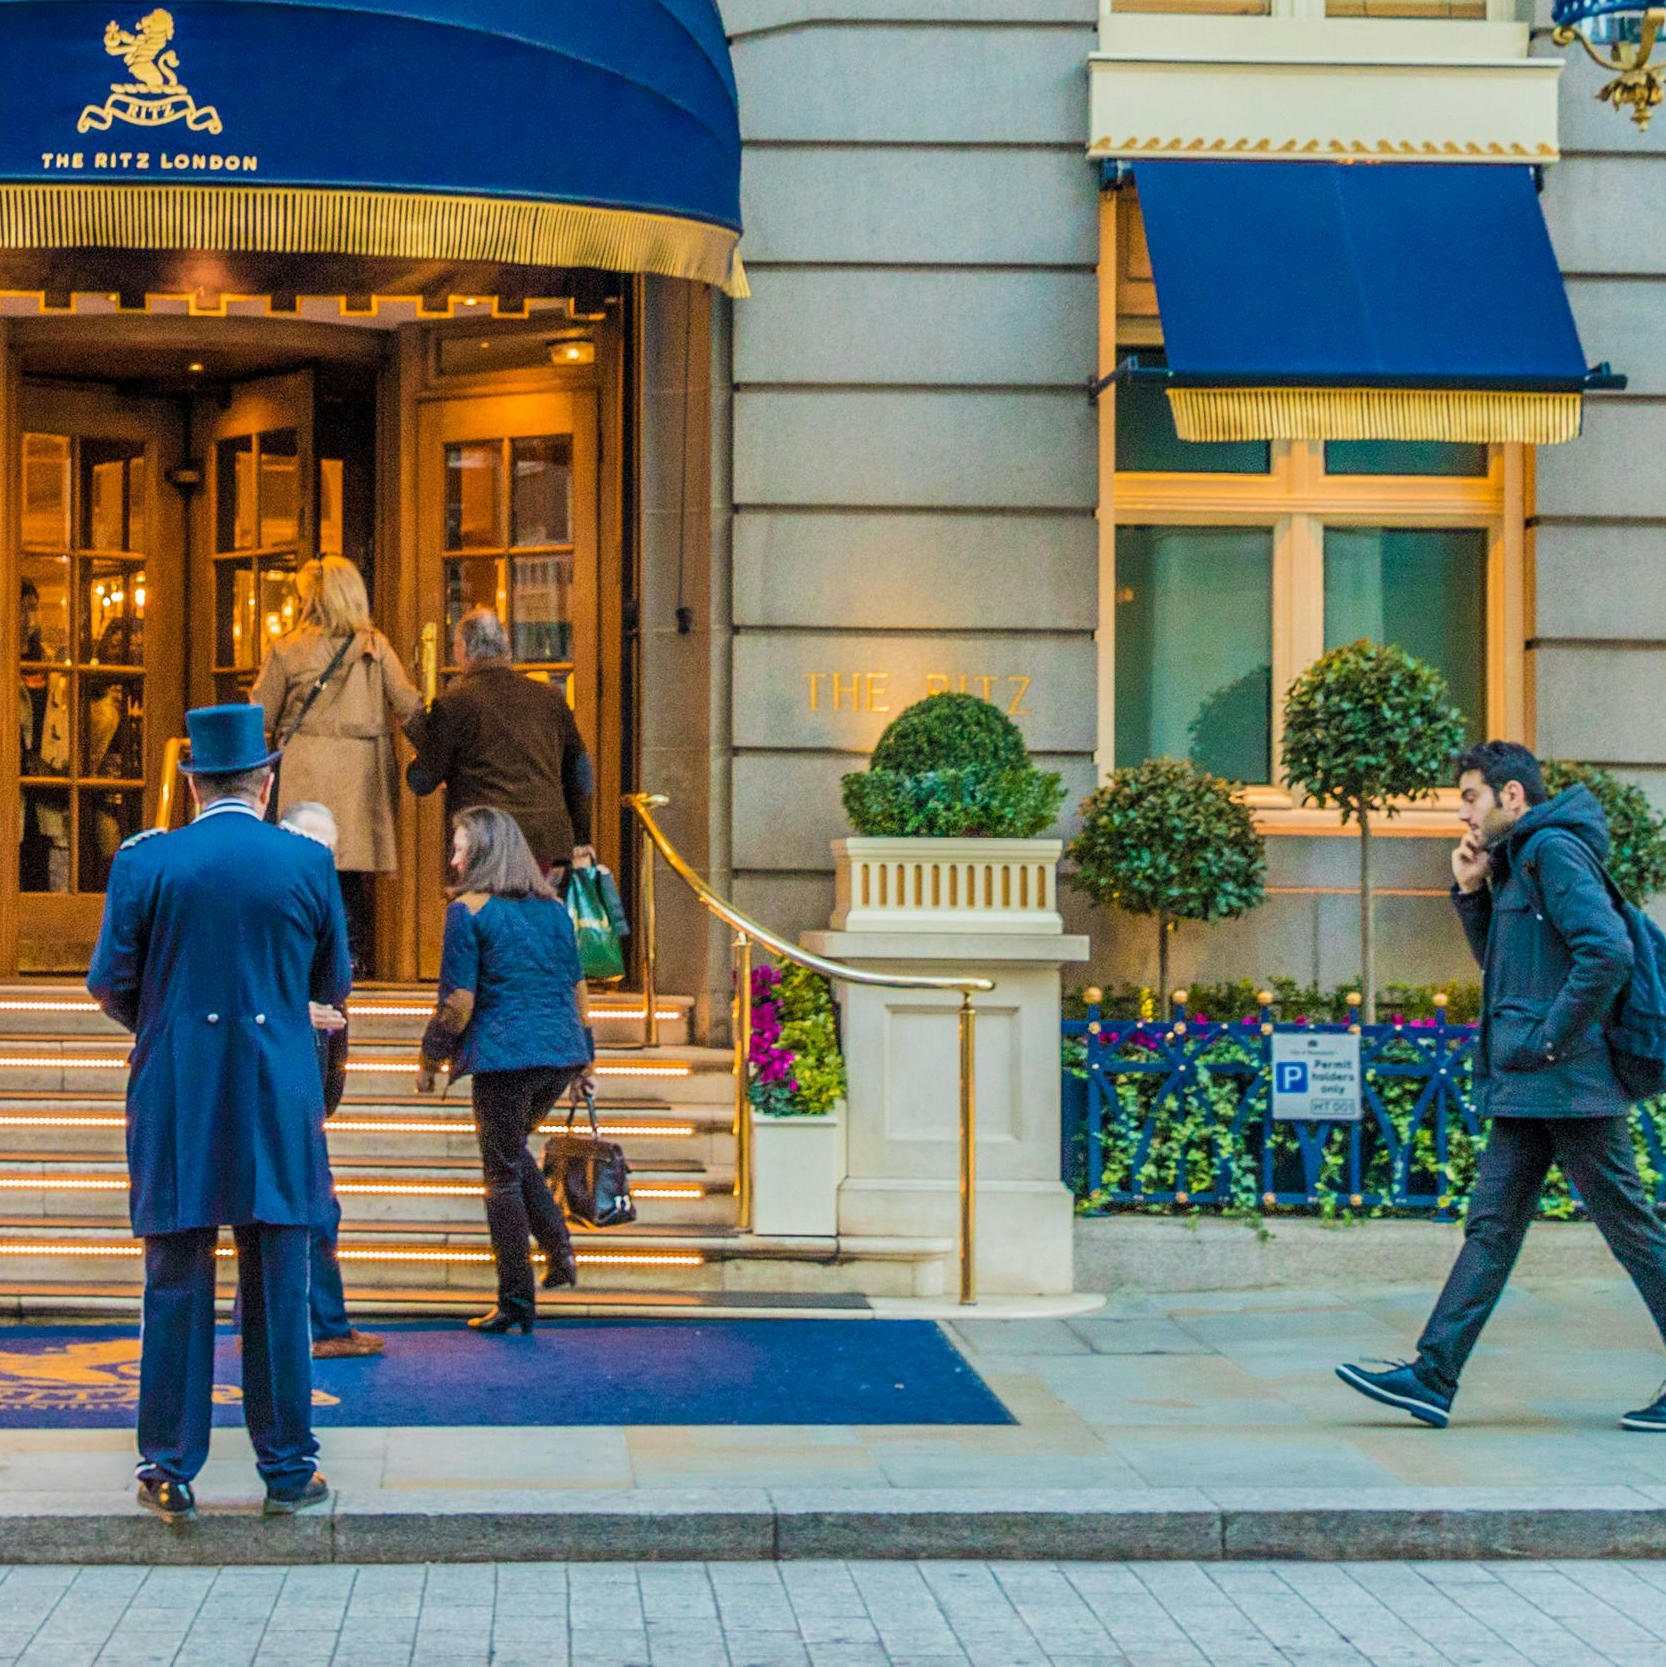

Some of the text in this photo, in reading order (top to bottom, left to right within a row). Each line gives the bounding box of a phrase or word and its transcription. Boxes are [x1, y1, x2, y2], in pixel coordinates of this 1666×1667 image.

[126, 101, 175, 120] RITZ
[41, 152, 258, 172] THE RITZ LONDON
[802, 673, 890, 712] THE
[1314, 1059, 1352, 1069] Permit
[1284, 1066, 1302, 1090] P
[1312, 1072, 1354, 1082] holders
[1320, 1085, 1345, 1095] only
